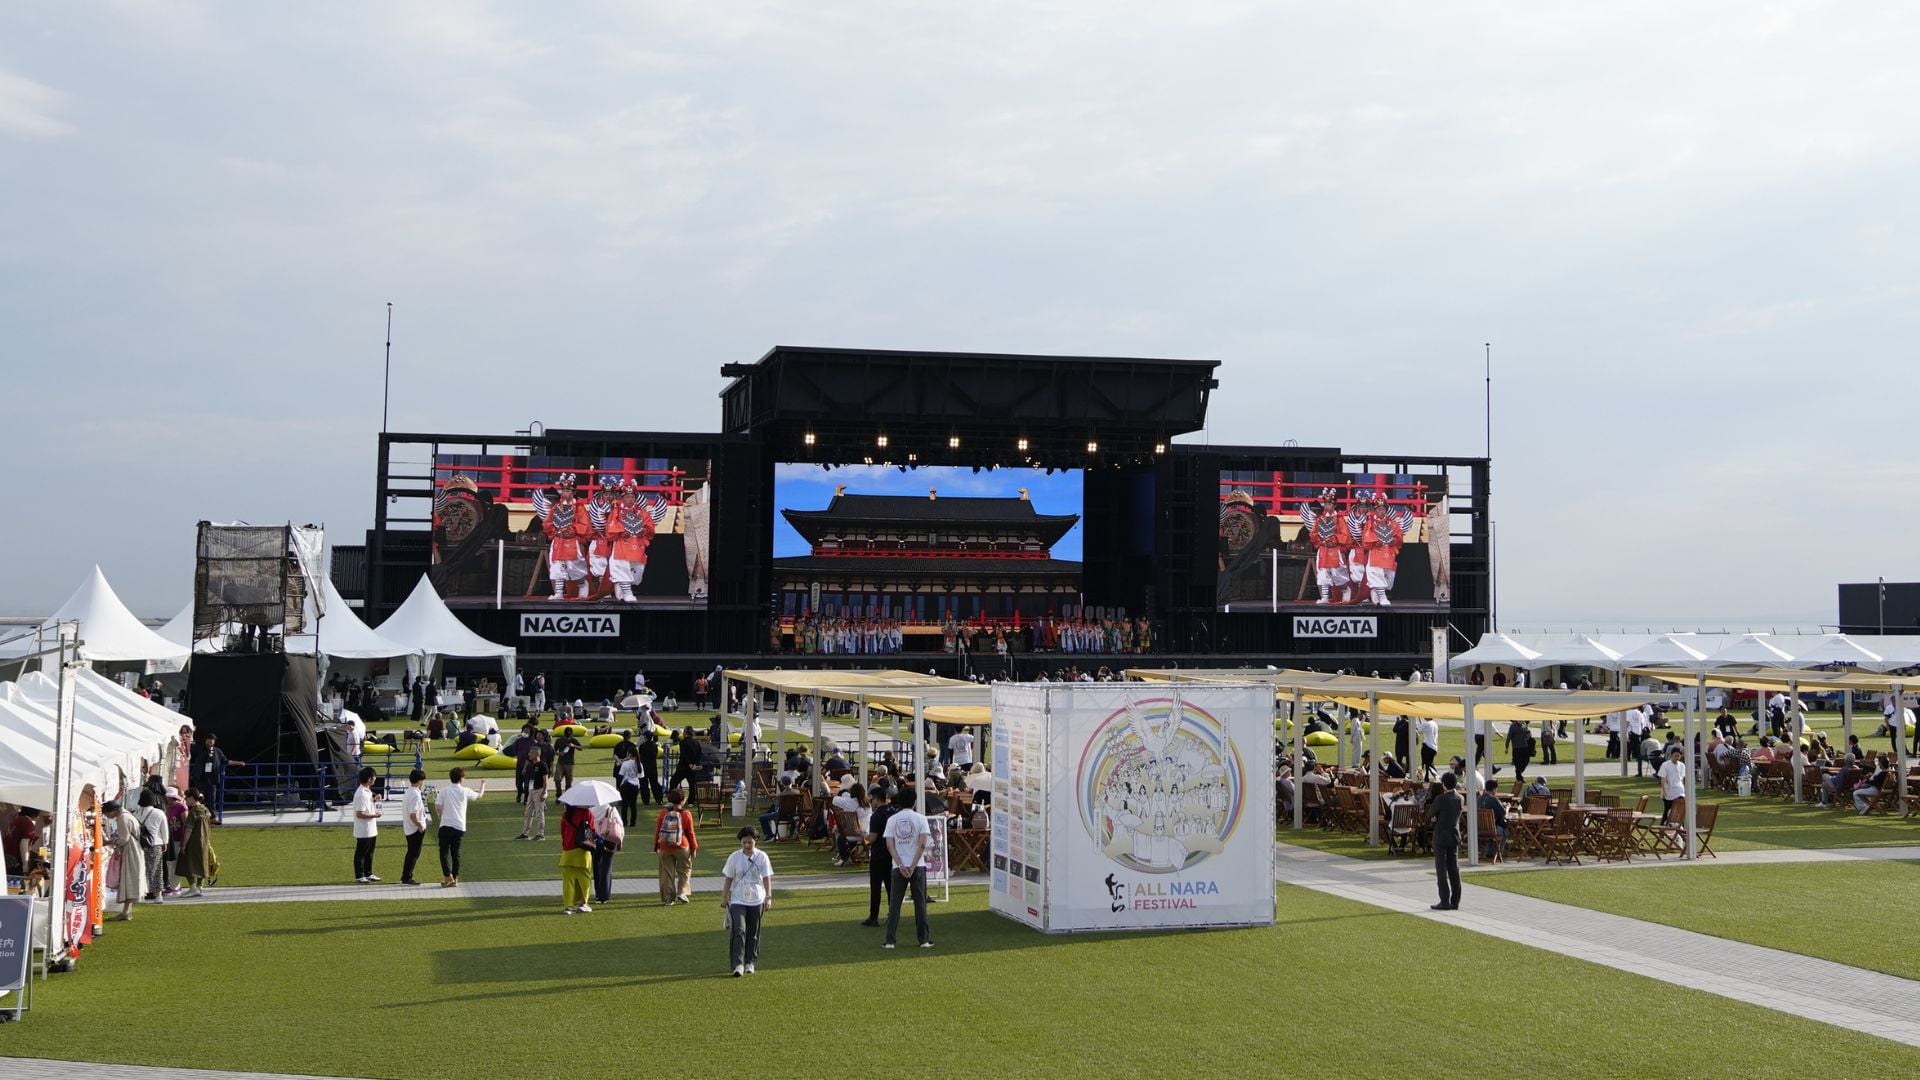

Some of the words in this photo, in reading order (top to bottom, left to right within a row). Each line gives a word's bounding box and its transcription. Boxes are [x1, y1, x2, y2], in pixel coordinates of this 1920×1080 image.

[524, 616, 616, 633] NAGATA
[1296, 619, 1374, 634] NAGATA
[1134, 883, 1166, 896] ALL
[1170, 881, 1219, 896] NARA
[1134, 898, 1197, 910] FESTIVAL
